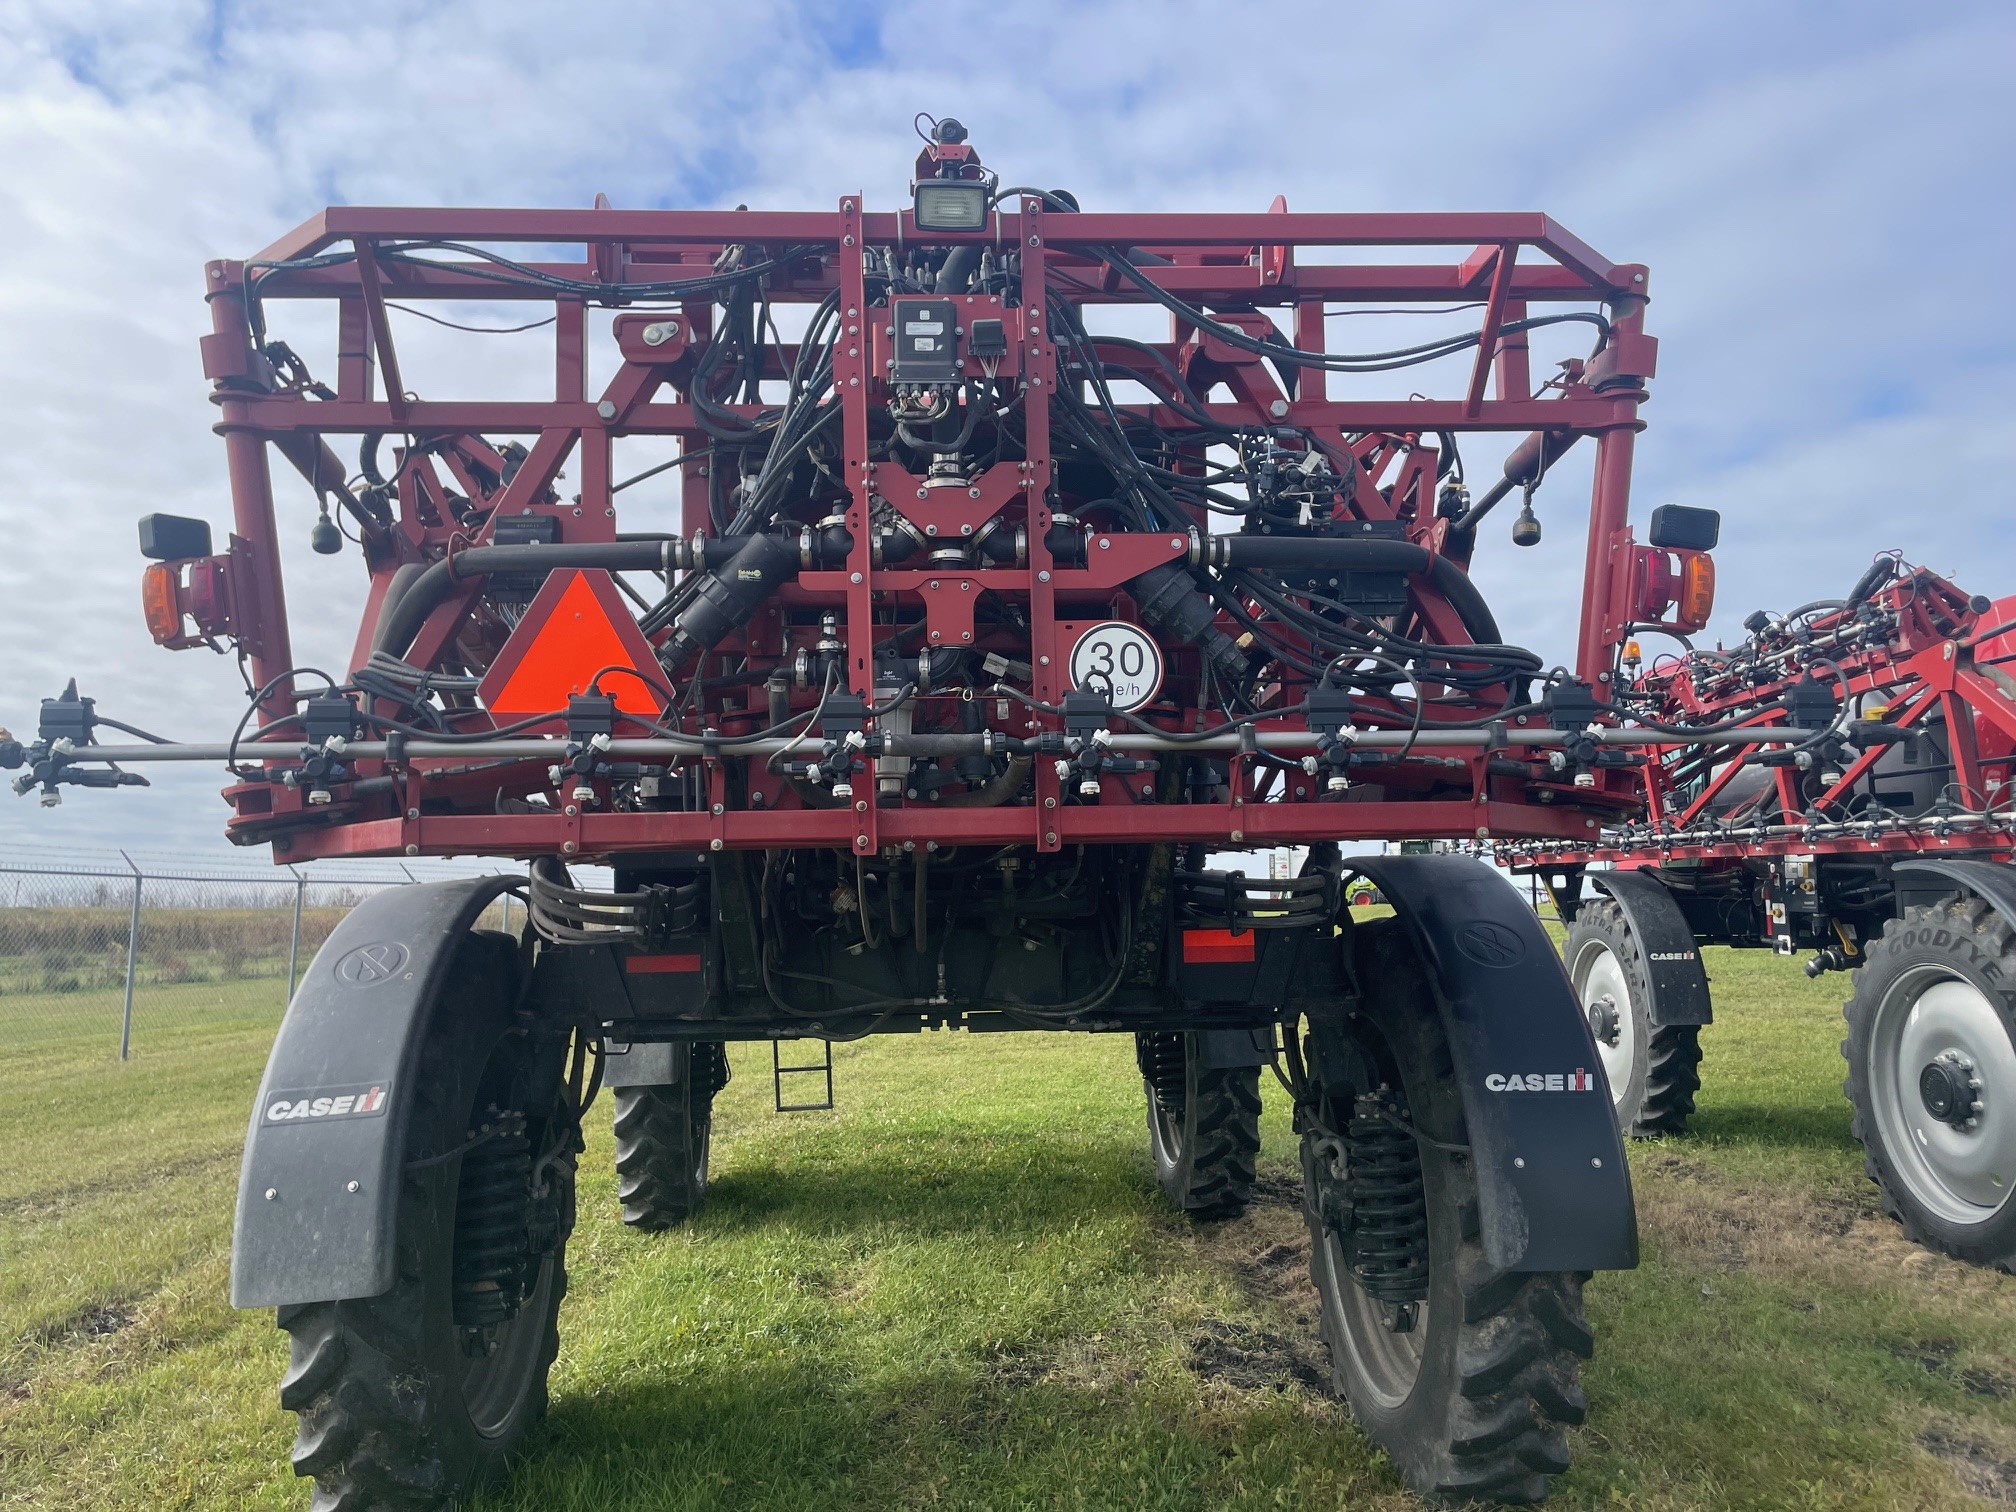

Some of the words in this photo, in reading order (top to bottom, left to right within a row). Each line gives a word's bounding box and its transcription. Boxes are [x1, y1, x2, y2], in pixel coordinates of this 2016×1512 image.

[1091, 642, 1144, 677] 30
[1093, 683, 1140, 695] me/h
[1619, 942, 1643, 1012] SPRA
[1888, 928, 2016, 1020] GOODYEA
[1485, 1073, 1564, 1092] CASE
[267, 1095, 355, 1121] CASE
